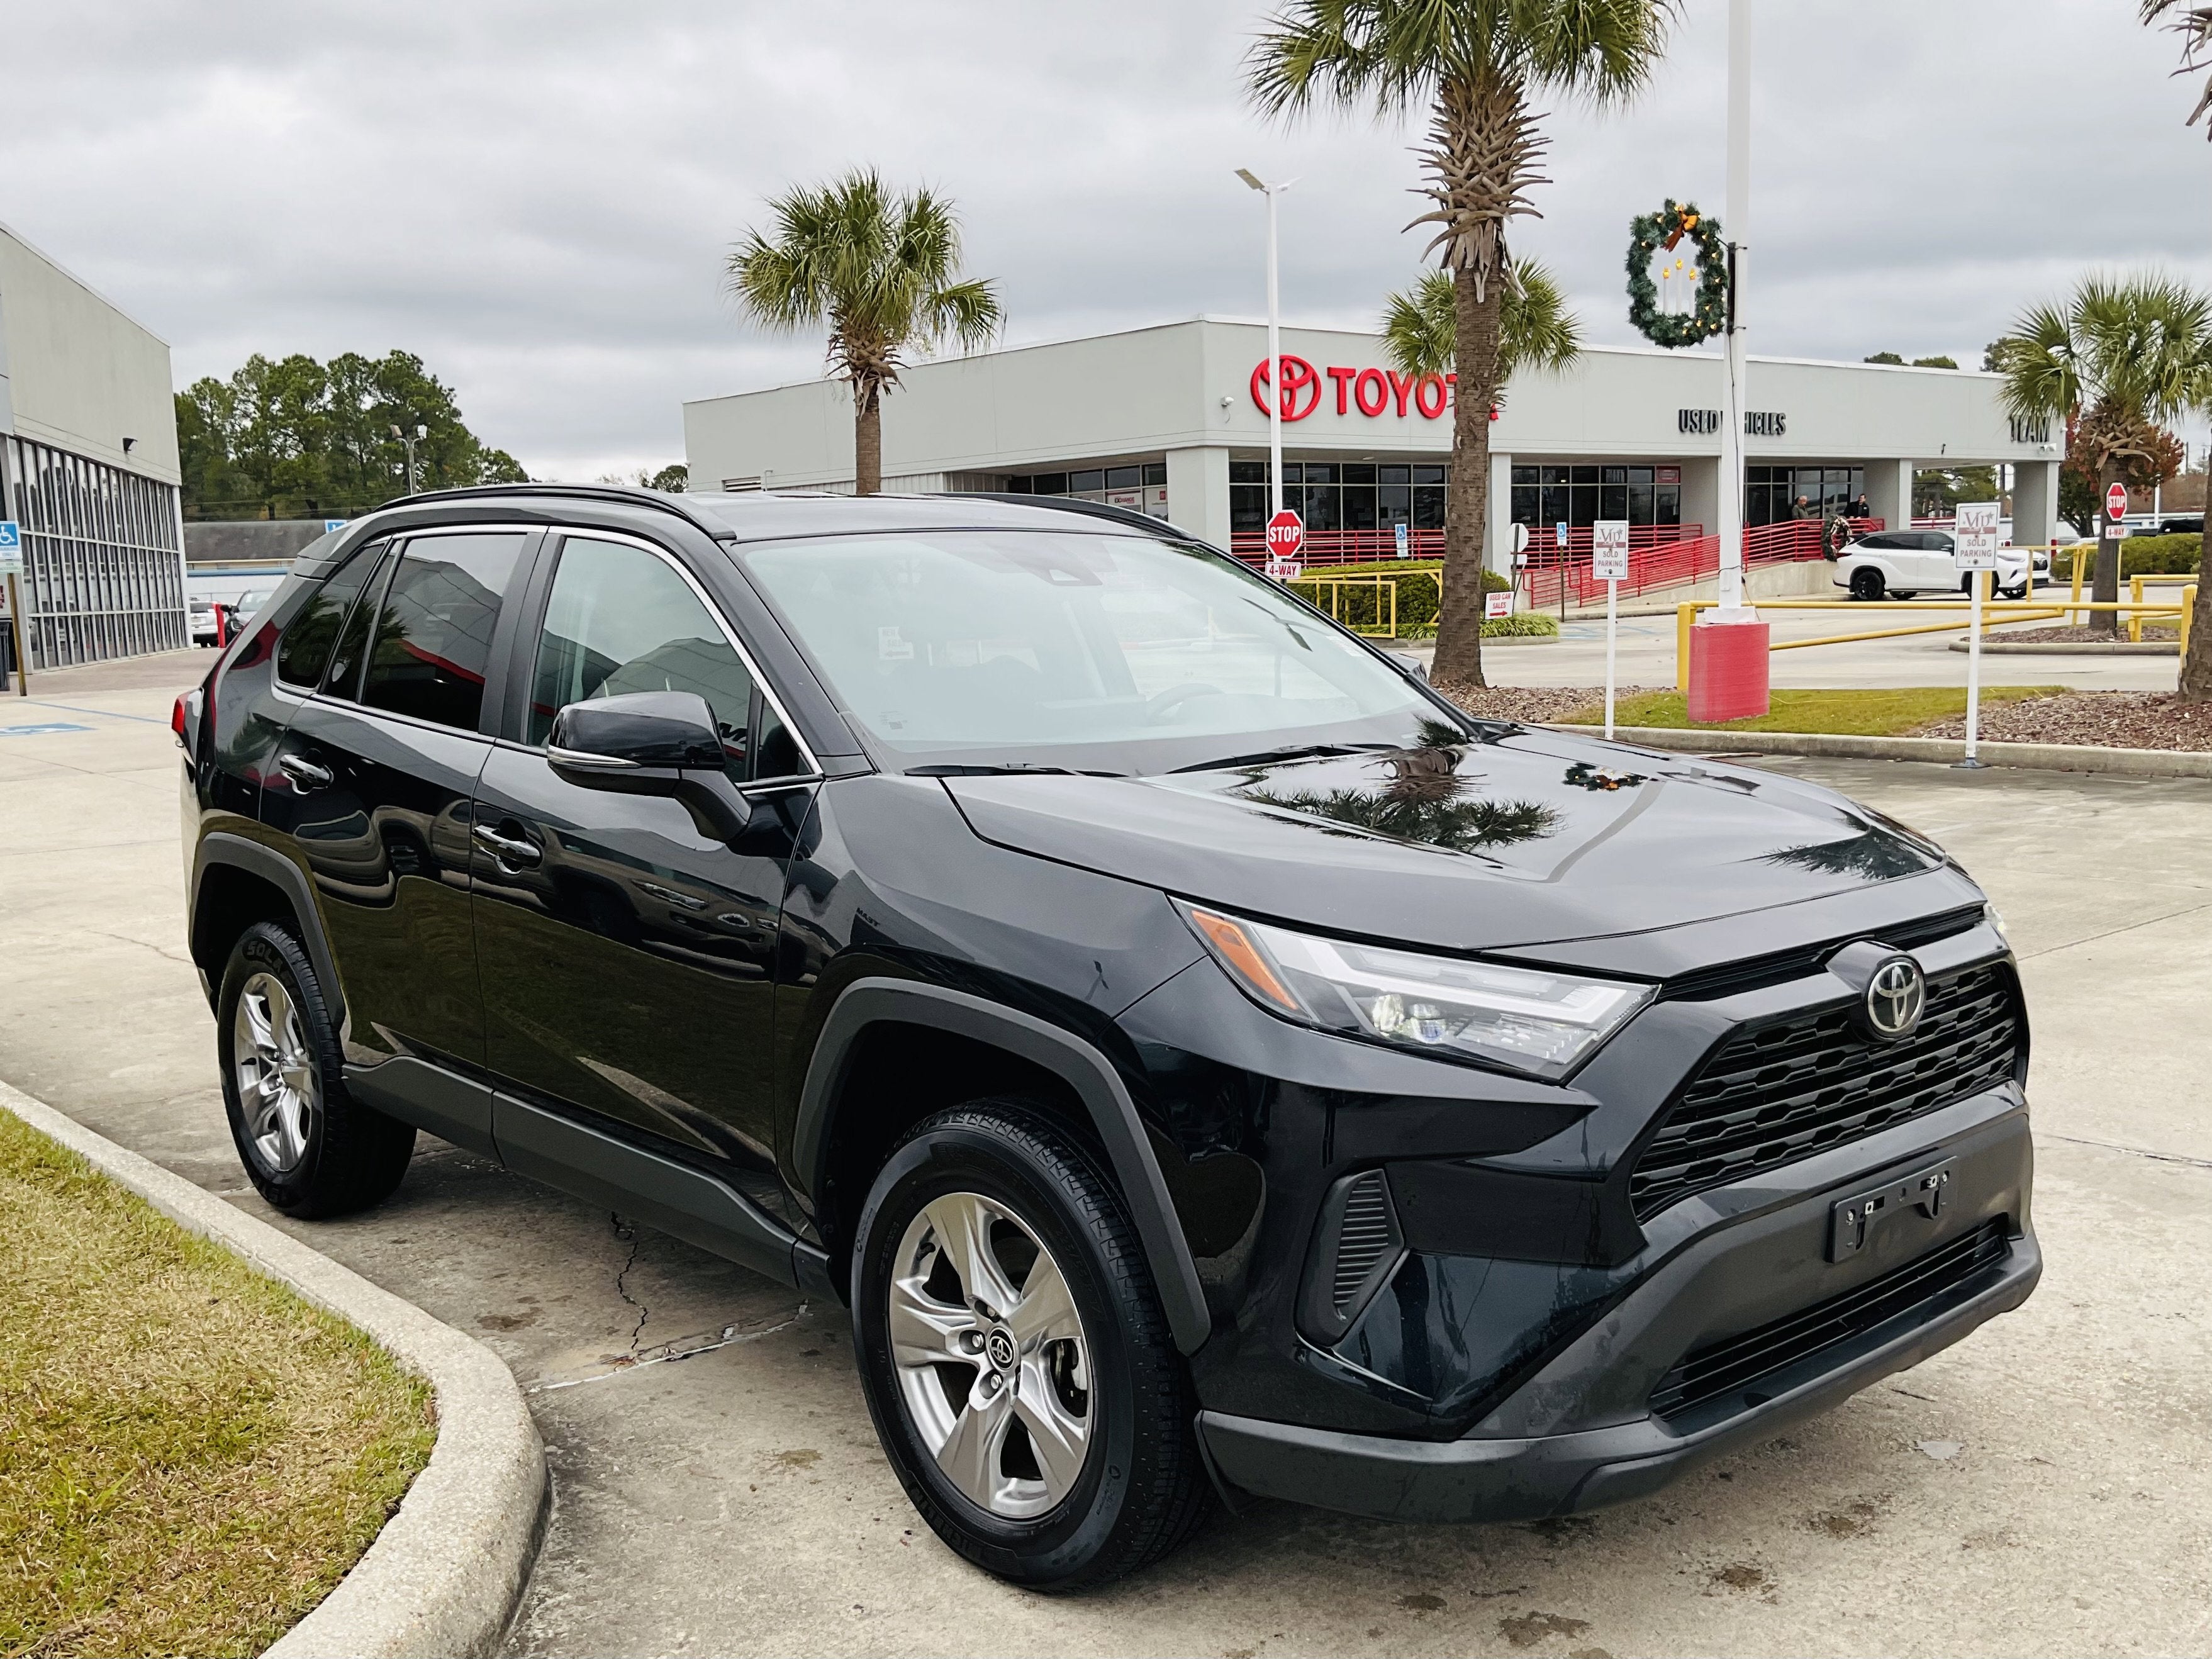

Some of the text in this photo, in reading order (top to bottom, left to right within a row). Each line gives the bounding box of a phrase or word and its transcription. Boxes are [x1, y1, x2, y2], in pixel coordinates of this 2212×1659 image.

[1327, 367, 1499, 420] TOYO
[1679, 409, 1719, 433] USED
[2108, 495, 2125, 508] STOP
[1269, 526, 1300, 542] STOP
[2108, 528, 2125, 537] 4-WAY
[1960, 549, 1992, 557] PARKING
[1269, 565, 1297, 576] 4-WAY
